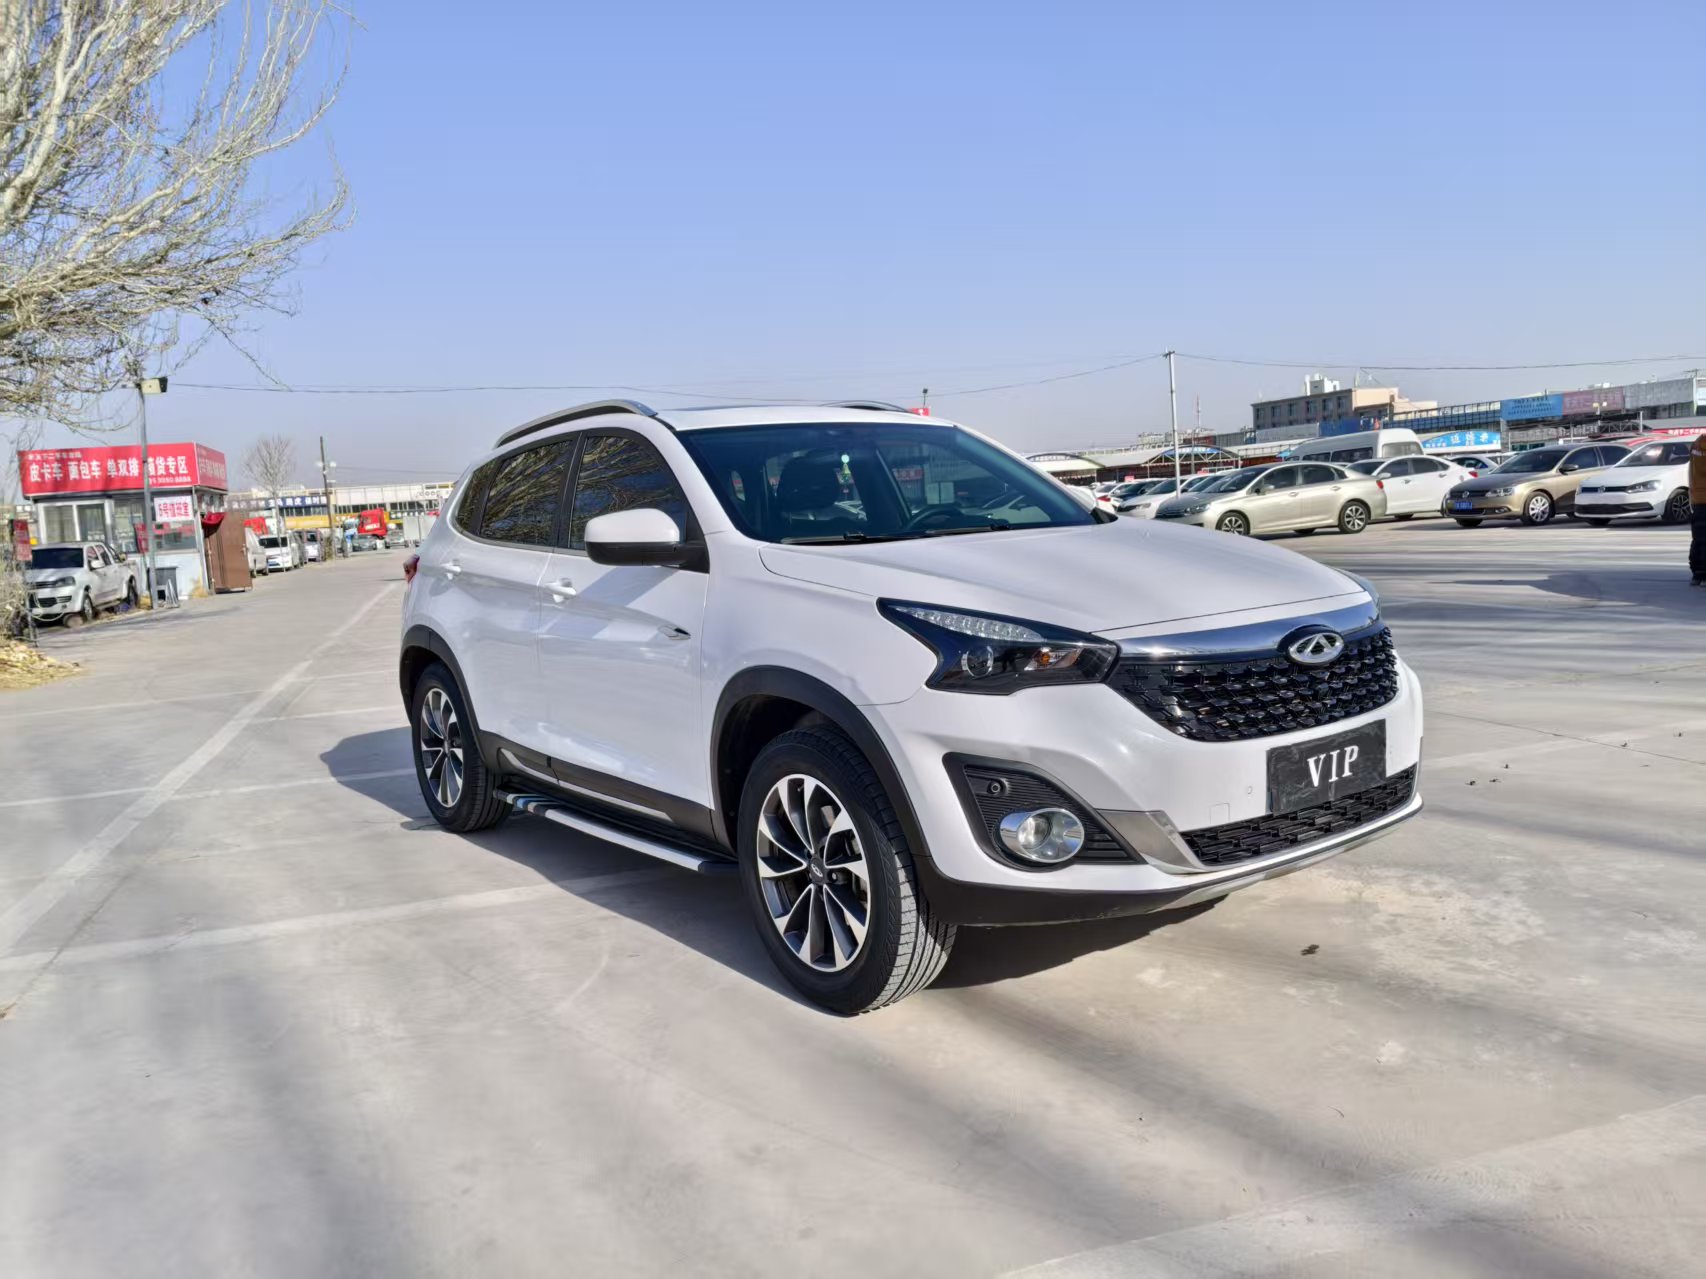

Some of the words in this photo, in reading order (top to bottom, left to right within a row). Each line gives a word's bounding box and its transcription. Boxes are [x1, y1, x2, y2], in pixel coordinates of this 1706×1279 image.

[30, 462, 63, 482] 皮卡车
[67, 459, 102, 481] 面包车
[1306, 744, 1360, 788] VIP
